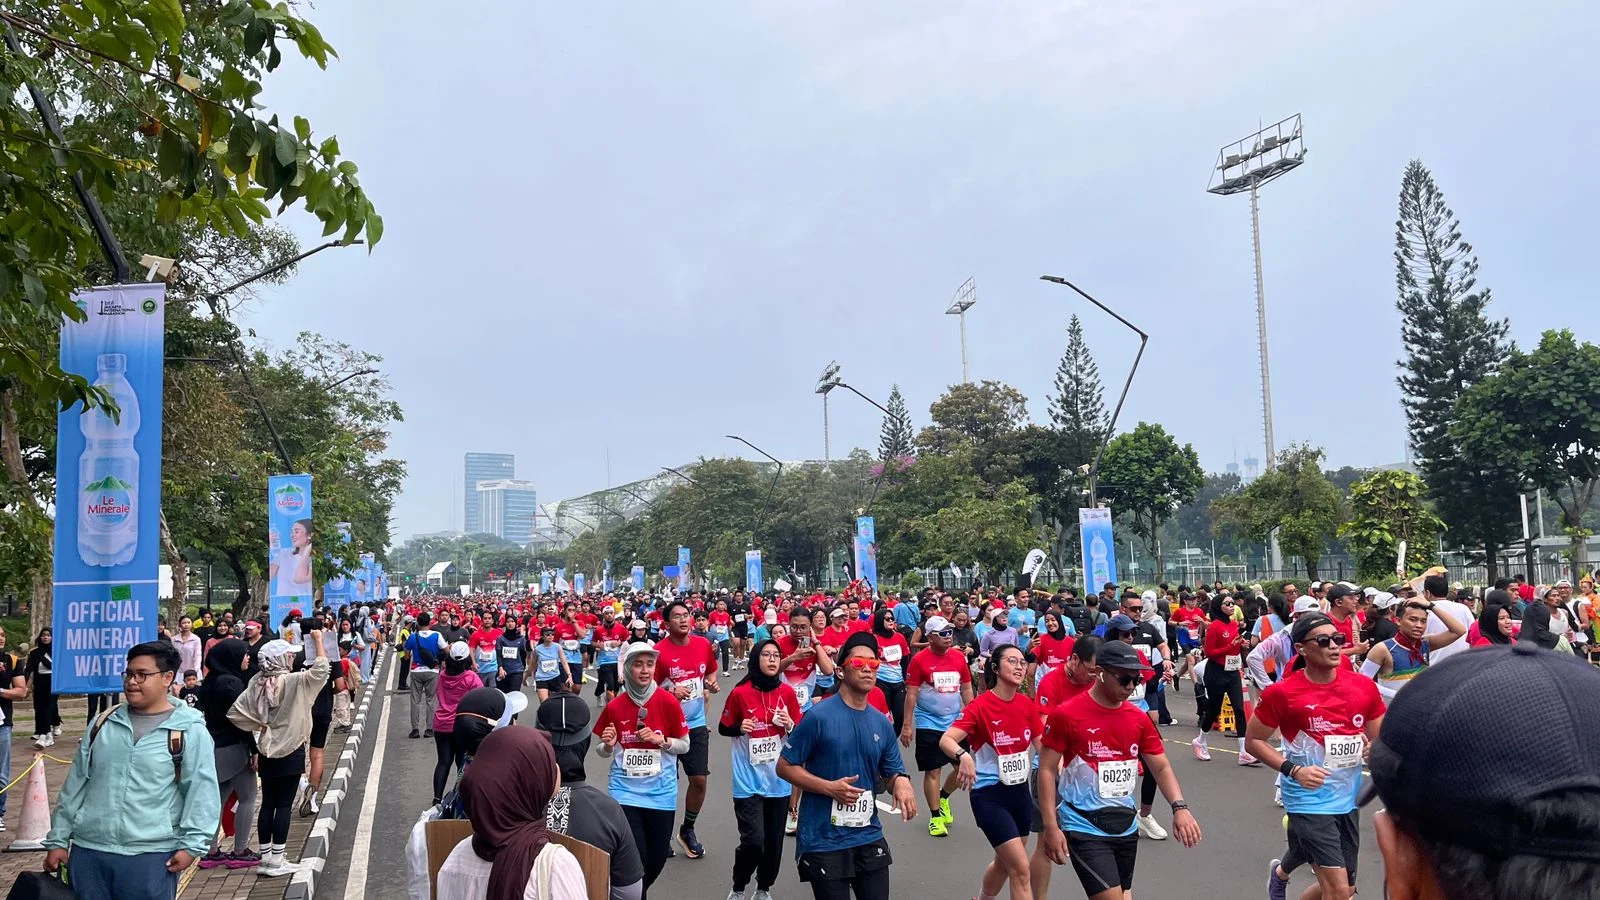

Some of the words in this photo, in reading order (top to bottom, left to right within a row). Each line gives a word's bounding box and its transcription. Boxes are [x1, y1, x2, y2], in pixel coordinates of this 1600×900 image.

[102, 496, 114, 505] Le
[88, 504, 130, 514] Minerale
[68, 600, 144, 623] OFFICIAL
[74, 654, 127, 677] WATE
[752, 742, 777, 754] 54322
[1330, 741, 1361, 756] 53807
[626, 754, 653, 766] 50656
[1003, 759, 1026, 773] 56901
[1103, 768, 1131, 783] 60238
